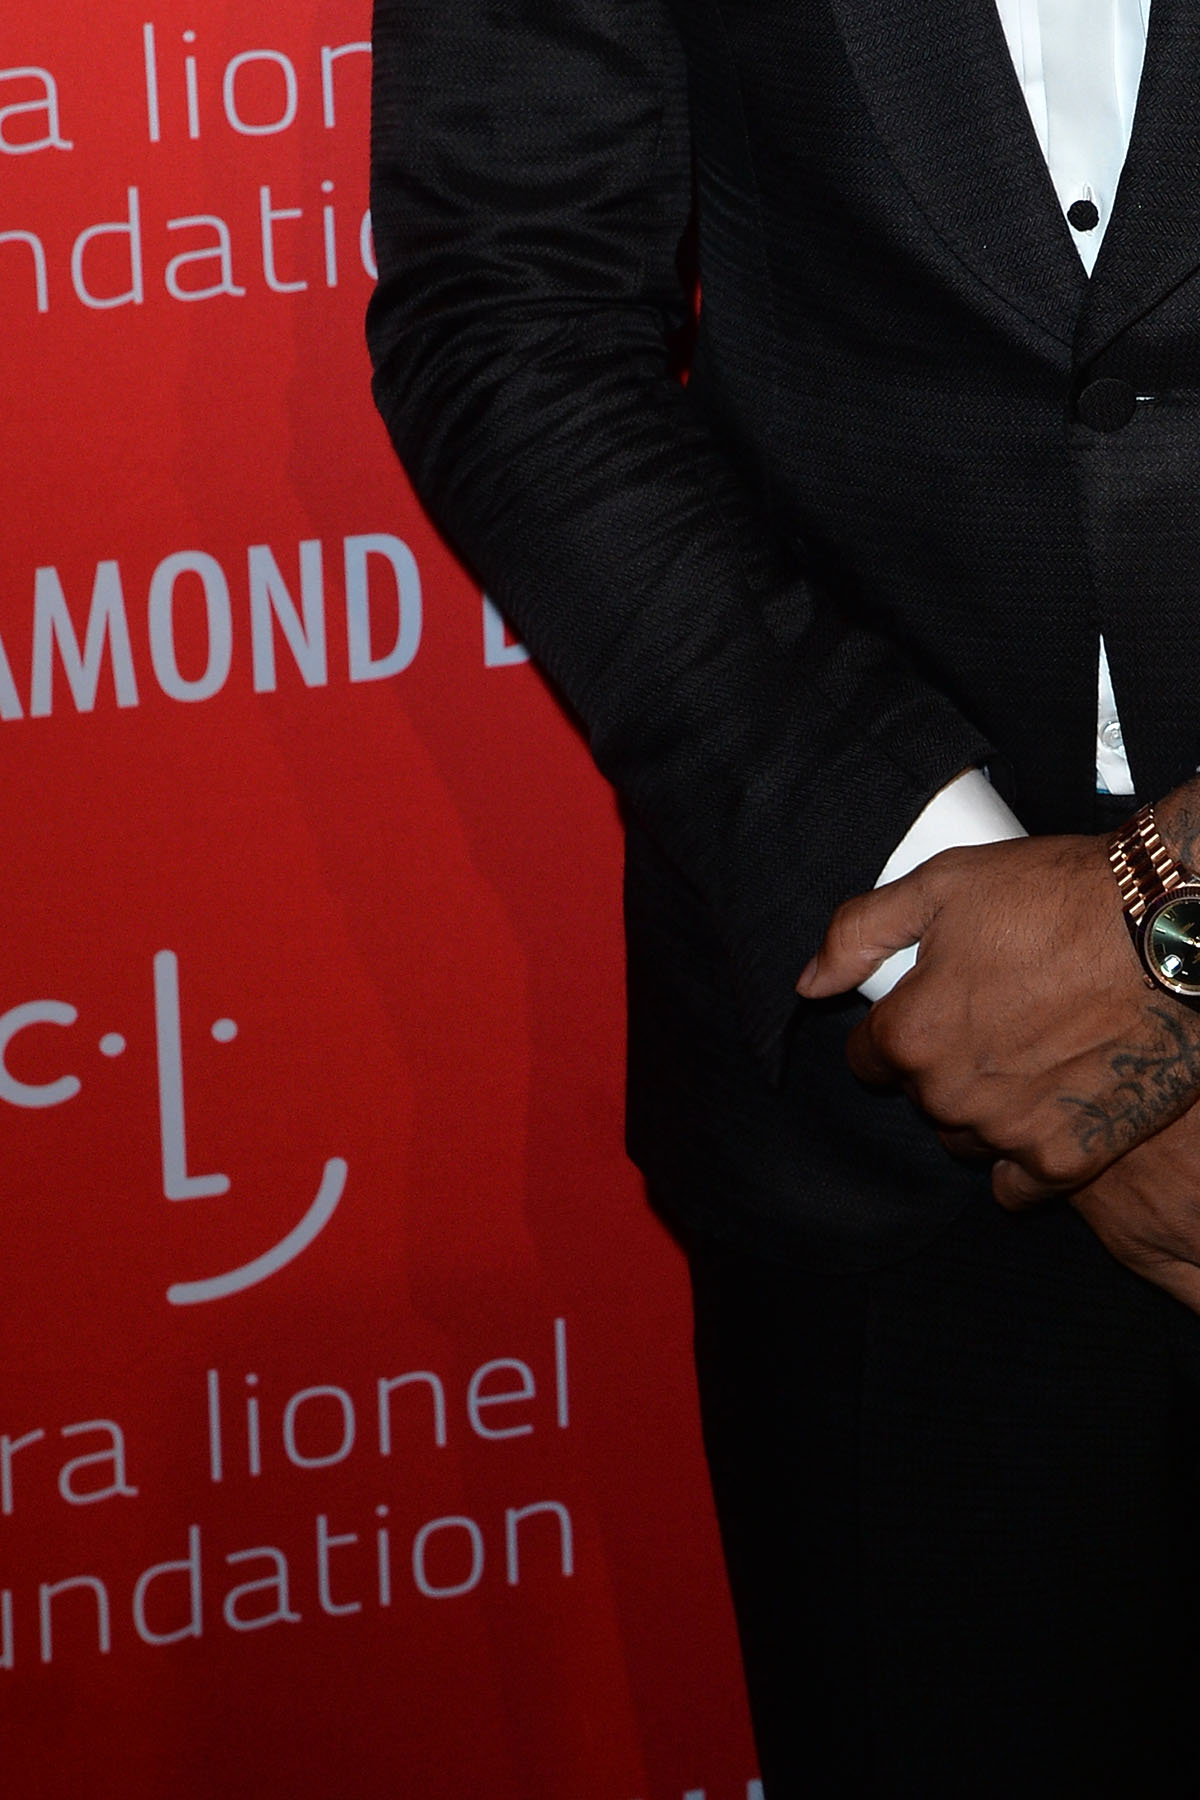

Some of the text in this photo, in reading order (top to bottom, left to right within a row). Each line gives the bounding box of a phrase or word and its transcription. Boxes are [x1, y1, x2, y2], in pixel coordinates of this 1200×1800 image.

[0, 179, 380, 314] ndati
[0, 531, 424, 722] MOND
[207, 1316, 570, 1483] lionel
[0, 1500, 575, 1670] ndation
